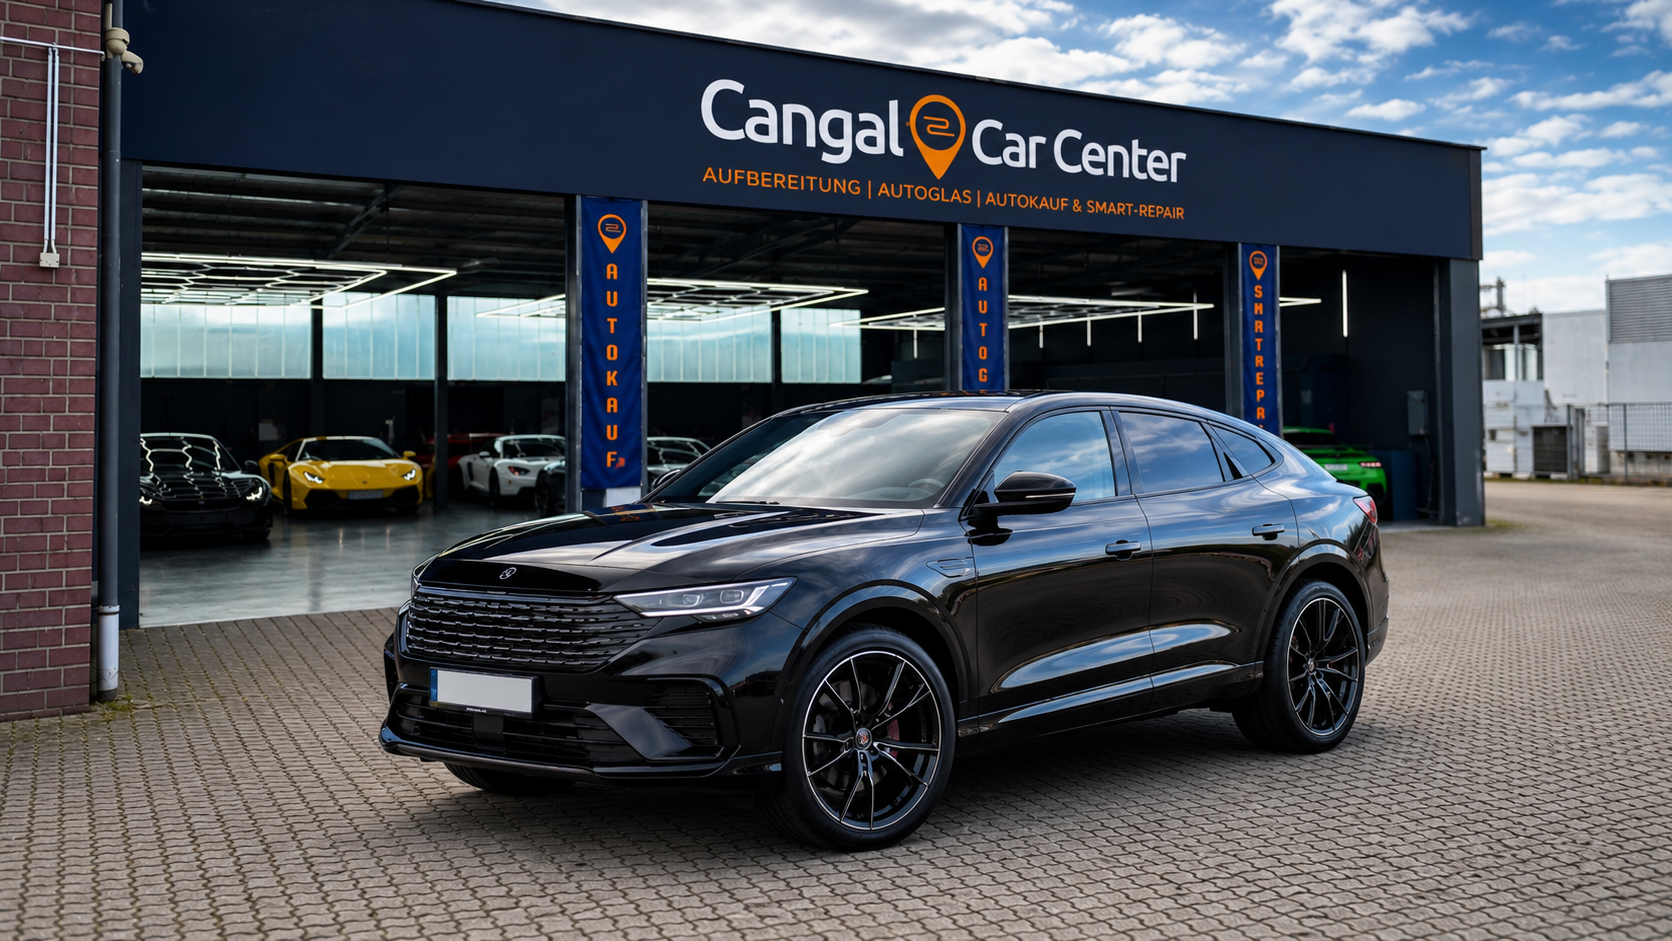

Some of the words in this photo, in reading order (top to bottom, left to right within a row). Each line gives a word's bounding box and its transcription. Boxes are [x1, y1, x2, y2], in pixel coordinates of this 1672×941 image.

[700, 79, 904, 164] Cangal
[971, 119, 1047, 169] Car
[1053, 128, 1187, 183] Center
[702, 166, 861, 195] AUFBEREITUNG
[877, 182, 972, 204] AUTOGLAS
[985, 191, 1069, 211] AUTOKAUF
[1072, 198, 1083, 213] &
[1086, 199, 1185, 220] SMART-REPAIR
[606, 263, 618, 468] AUTOKAUF
[978, 276, 988, 393] AUTOG
